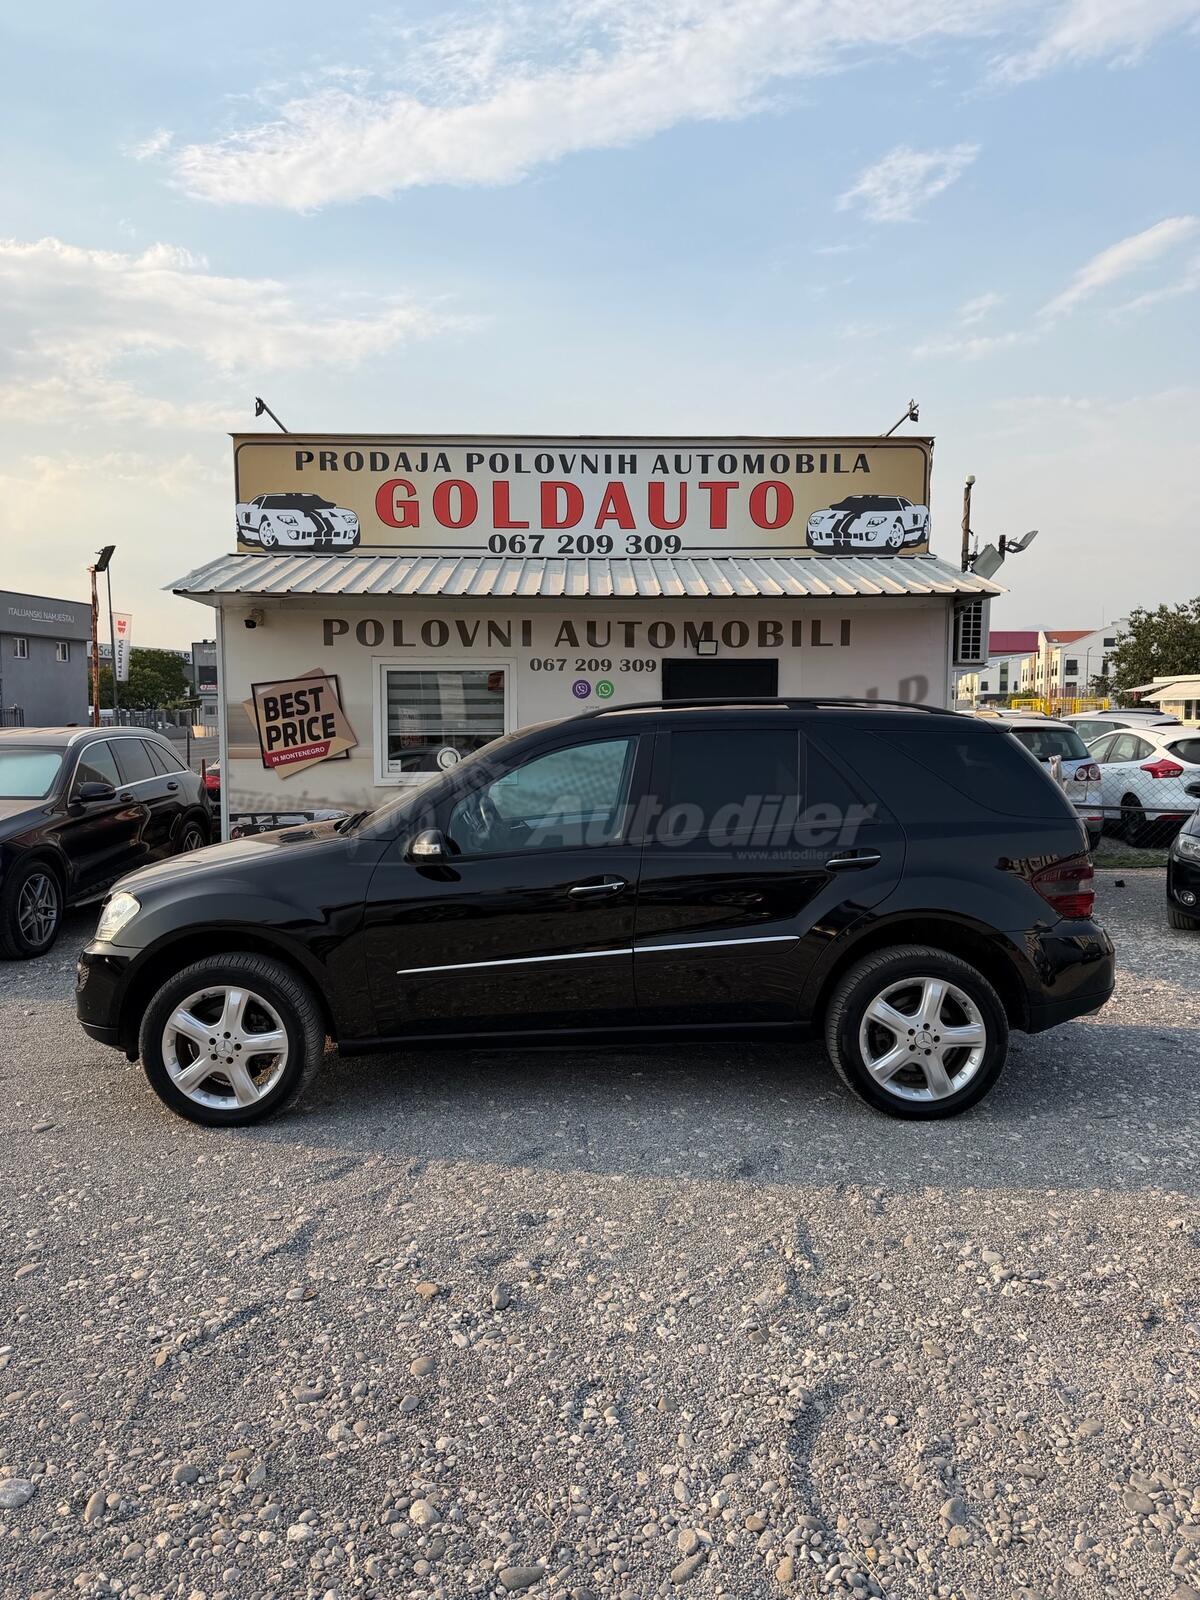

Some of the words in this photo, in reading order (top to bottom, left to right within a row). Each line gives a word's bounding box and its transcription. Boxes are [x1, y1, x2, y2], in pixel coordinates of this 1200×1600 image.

[295, 450, 452, 473] PRODAJA
[466, 452, 637, 475] POLOVNIH
[651, 453, 871, 475] AUTOMOBILA
[374, 478, 795, 530] GOLDAUTO
[488, 534, 545, 554] 067
[557, 534, 614, 555] 209
[625, 534, 682, 555] 309
[322, 618, 532, 648] POLOVNI
[554, 618, 851, 649] AUTOMOBILI
[529, 657, 567, 672] 067
[574, 658, 613, 673] 209
[618, 658, 657, 673] 309
[264, 686, 324, 722] BEST
[266, 713, 337, 751] PRICE
[280, 746, 326, 761] MONTENEGRO
